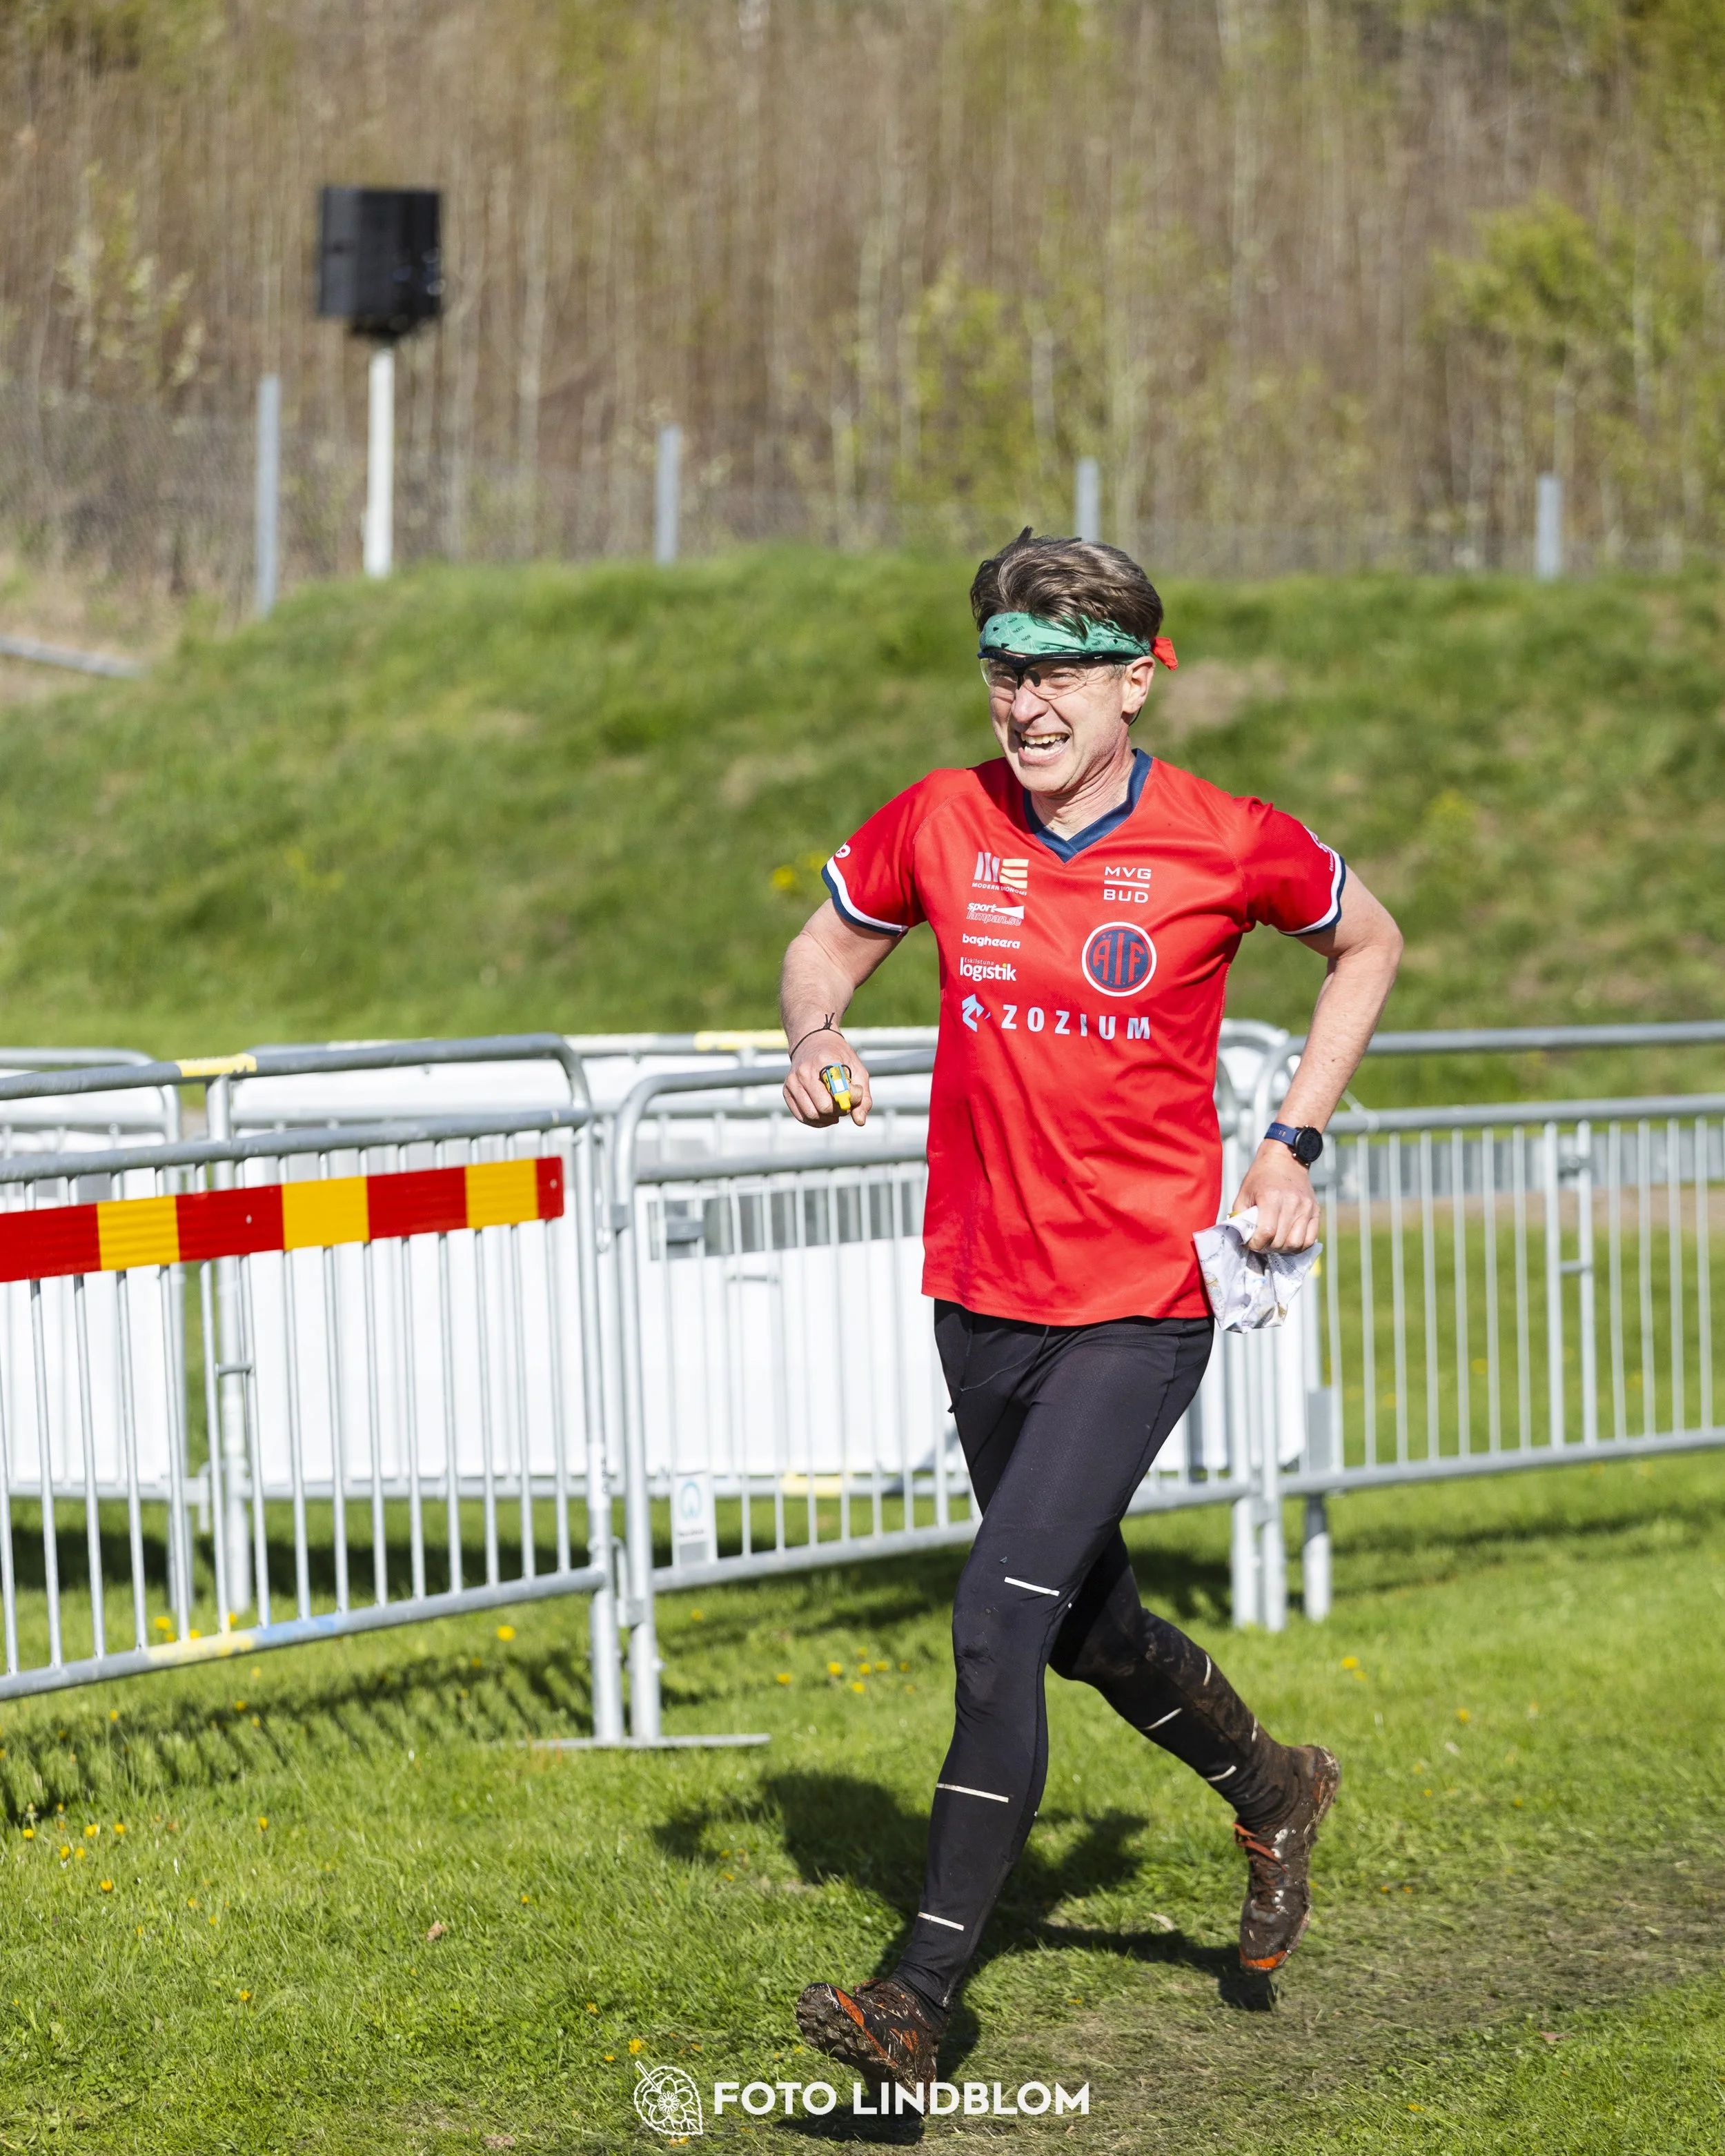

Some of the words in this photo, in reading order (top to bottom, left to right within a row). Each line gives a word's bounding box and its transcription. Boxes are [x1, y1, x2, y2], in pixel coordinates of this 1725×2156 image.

[1104, 866, 1152, 880] MVG
[971, 882, 1000, 891] MODERN
[1103, 889, 1149, 904] BUD
[967, 902, 997, 913] sport
[966, 910, 1022, 926] lampan.se
[962, 933, 1021, 949] bagheera
[964, 957, 995, 966] Eskilstuna
[960, 957, 1017, 982] logistik
[1001, 1004, 1151, 1040] ZOZIUM
